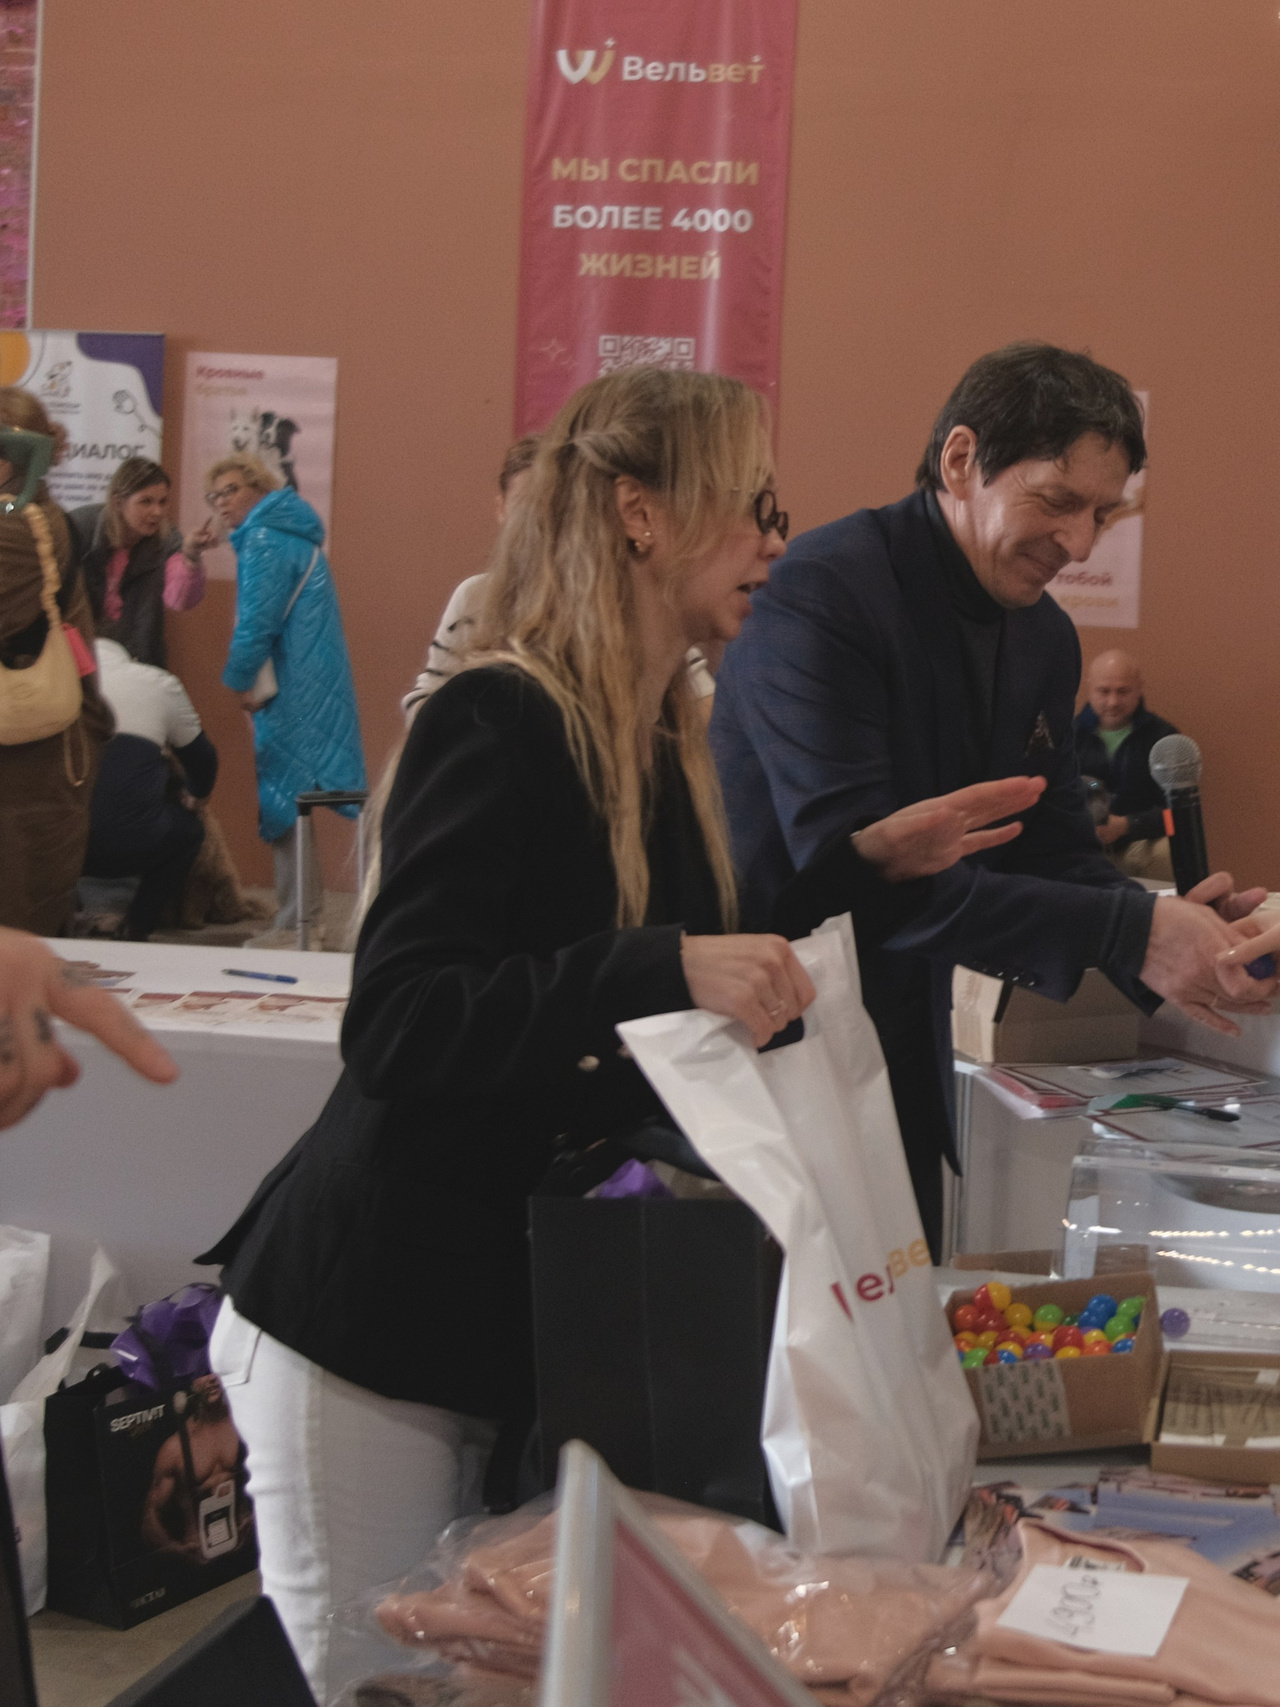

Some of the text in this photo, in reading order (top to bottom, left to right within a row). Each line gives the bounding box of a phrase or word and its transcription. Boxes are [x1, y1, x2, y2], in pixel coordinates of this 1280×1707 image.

[621, 54, 764, 84] Вельвет
[551, 158, 760, 186] МЫ СПАСЛИ
[552, 204, 754, 233] БОЛЕЕ 4000
[578, 250, 722, 281] ЖИЗНЕЙ
